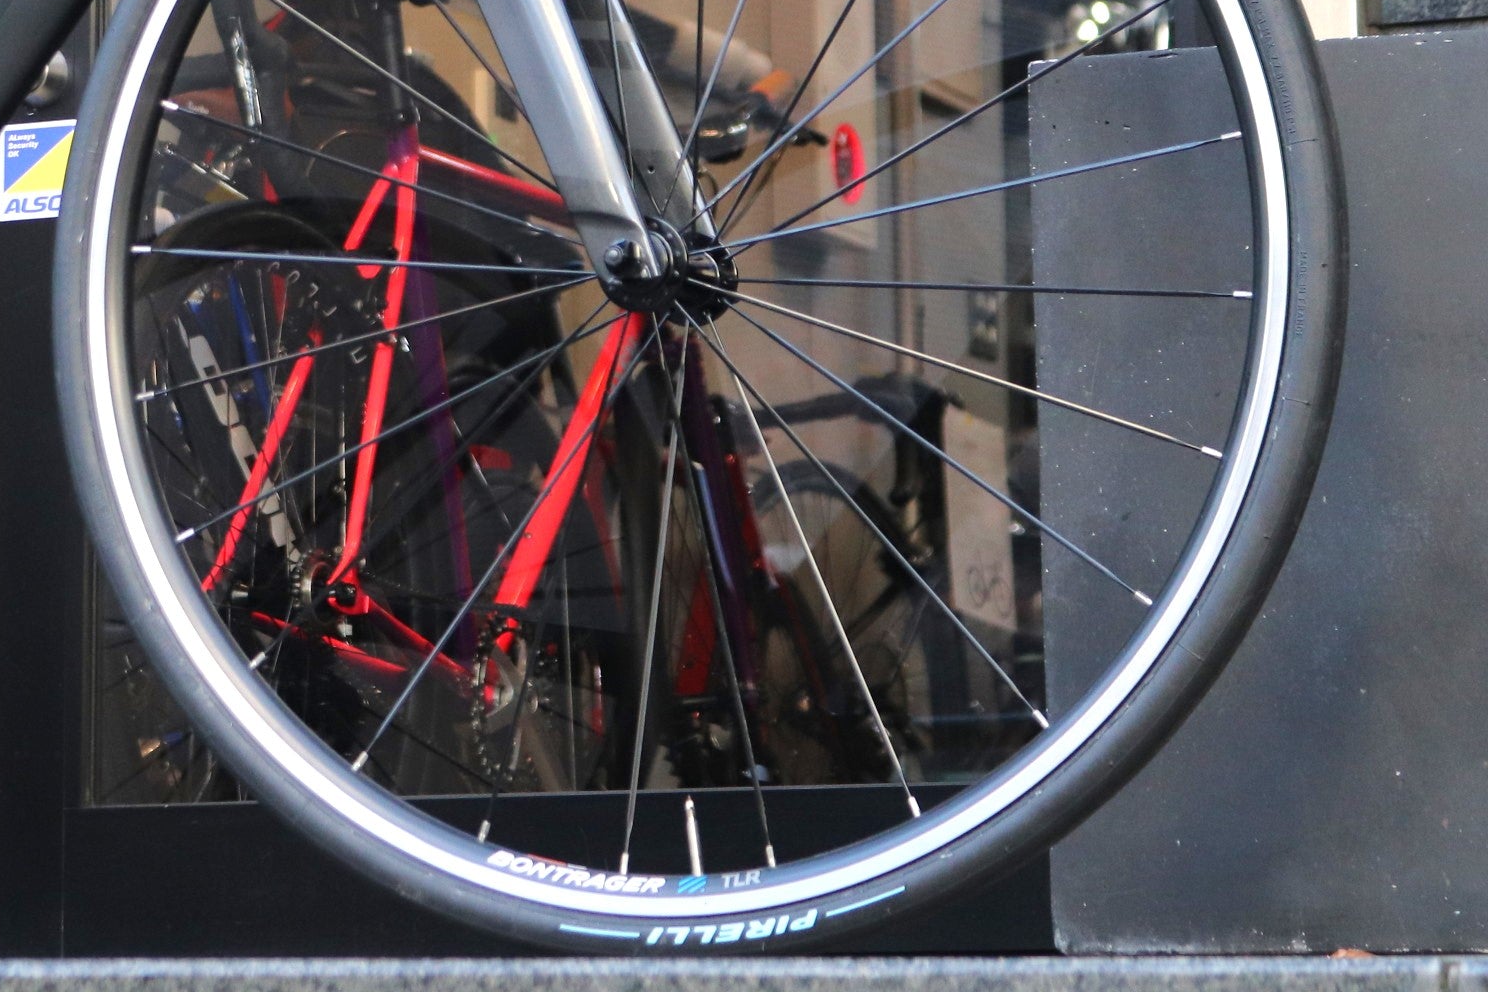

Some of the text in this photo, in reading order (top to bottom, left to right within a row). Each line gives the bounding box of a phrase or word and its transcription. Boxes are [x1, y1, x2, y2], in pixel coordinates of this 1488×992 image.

[8, 141, 40, 150] Security
[8, 150, 19, 158] OK
[487, 849, 762, 895] BONTRAGER TLR
[645, 908, 818, 946] PIRELLI
